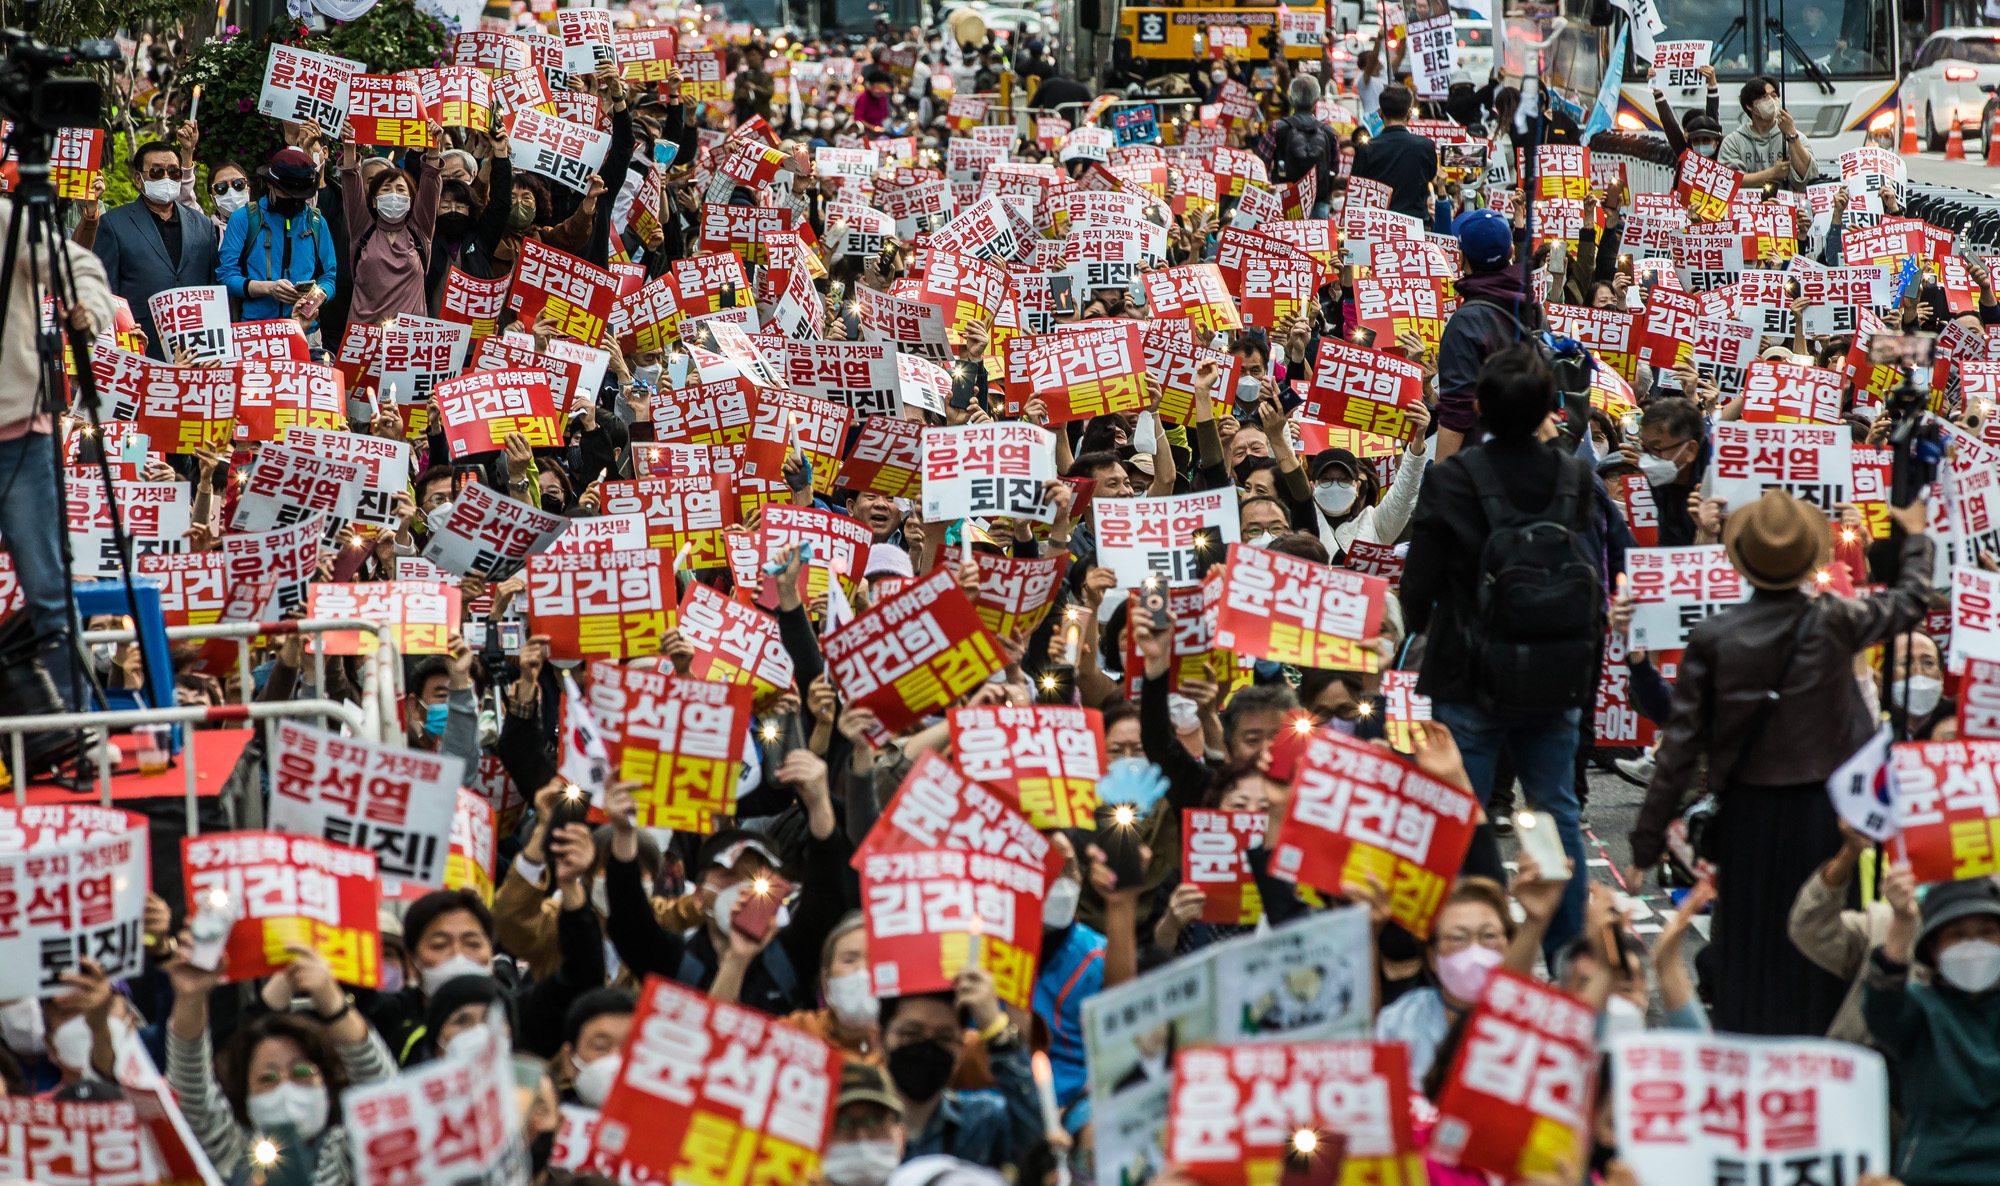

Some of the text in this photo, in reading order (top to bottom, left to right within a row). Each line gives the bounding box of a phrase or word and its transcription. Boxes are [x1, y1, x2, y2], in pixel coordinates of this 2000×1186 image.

[562, 22, 611, 47] 윤석열
[1656, 42, 1705, 52] 무능 무지 거짓말
[275, 50, 351, 84] 무능 무지 거짓말
[1654, 51, 1695, 69] 윤석열
[1668, 68, 1702, 87] 퇴진!
[269, 62, 339, 100] 윤석열
[351, 76, 392, 91] 주가조작
[421, 76, 490, 109] 윤석열
[351, 91, 418, 119] 김건희
[376, 118, 434, 146] 특검!
[514, 120, 585, 160] 윤석열
[1553, 144, 1583, 155] 허위경력
[534, 149, 593, 190] 퇴진!
[1681, 162, 1735, 202] 윤석열
[1686, 151, 1734, 179] 무능 무지 거짓말
[906, 184, 946, 202] 무지 거짓말
[704, 215, 783, 242] 윤석열
[933, 200, 993, 246] 무능 무지 거짓말
[1347, 219, 1408, 242] 윤석열
[1738, 212, 1793, 240] 윤석열
[1845, 220, 1924, 244] 주가조작 허위경력
[1671, 249, 1724, 271] 윤석열
[1846, 234, 1908, 262] 김건희
[450, 272, 491, 294] 주가조작
[519, 262, 593, 311] 김건희
[524, 241, 619, 298] 주가조작 허위경력
[156, 289, 216, 308] 무지 거짓말
[608, 286, 678, 336] 윤석열
[1149, 275, 1227, 314] 윤석열
[1359, 288, 1438, 320] 윤석열
[1803, 282, 1873, 306] 윤석열
[1547, 303, 1633, 326] 주가조작 허위경력
[385, 348, 451, 372] 윤석열
[1029, 326, 1129, 361] 주가조작 허위경력
[1147, 334, 1191, 355] 주가조작
[242, 360, 332, 379] 무능 무지 거짓말
[789, 359, 870, 389] 윤석열
[1029, 346, 1132, 394] 김건희
[1321, 342, 1423, 383] 주가조작 허위경력
[144, 382, 237, 419] 윤석열
[240, 372, 341, 411] 윤석열
[676, 378, 738, 404] 무지 거짓말
[1067, 372, 1151, 416] 특검!
[1315, 360, 1401, 406] 김건희
[1744, 377, 1843, 424] 윤석열
[442, 387, 533, 426] 김건희
[652, 387, 748, 441] 윤석열
[1342, 397, 1410, 440] 특검!
[870, 416, 919, 437] 주가조작
[927, 428, 1046, 446] 무능 무지 거짓말
[1718, 427, 1838, 446] 무능 무지 거짓말
[287, 429, 398, 461] 무능 무지 거짓말
[927, 444, 1031, 481] 윤석열
[261, 448, 358, 483] 무능 무지 거짓말
[1718, 445, 1821, 481] 윤석열
[606, 476, 712, 498] 무능 무지 거짓말
[463, 484, 561, 535] 무능 무지 거짓말
[1098, 495, 1222, 518] 무능 무지 거짓말
[1236, 545, 1364, 594] 무능 무지 거짓말
[1630, 551, 1704, 569] 무능 무지
[824, 569, 956, 661] 주가조작 허위경력
[1228, 563, 1369, 640] 윤석열
[833, 618, 951, 699] 김건희
[893, 631, 1001, 713] 특검!
[592, 661, 728, 703] 무능 무지 거짓말
[590, 681, 736, 758] 윤석열
[955, 708, 1086, 729] 무능 무지 거짓말
[281, 727, 442, 784] 무능 무지 거짓말
[955, 728, 1099, 780] 윤석열
[277, 752, 412, 826] 윤석열
[1306, 738, 1474, 826] 주가조작 허위경력
[22, 807, 128, 834] 무지 거짓말
[1191, 811, 1226, 832] 무능
[1292, 769, 1438, 866] 김건희
[25, 840, 132, 880] 무지 거짓말
[187, 838, 376, 880] 주가조작 허위경력
[865, 853, 1045, 898] 주가조작 허위경력
[869, 878, 1016, 943] 김건희
[623, 1013, 832, 1150] 윤석열
[1629, 1080, 1820, 1153] 윤석열
